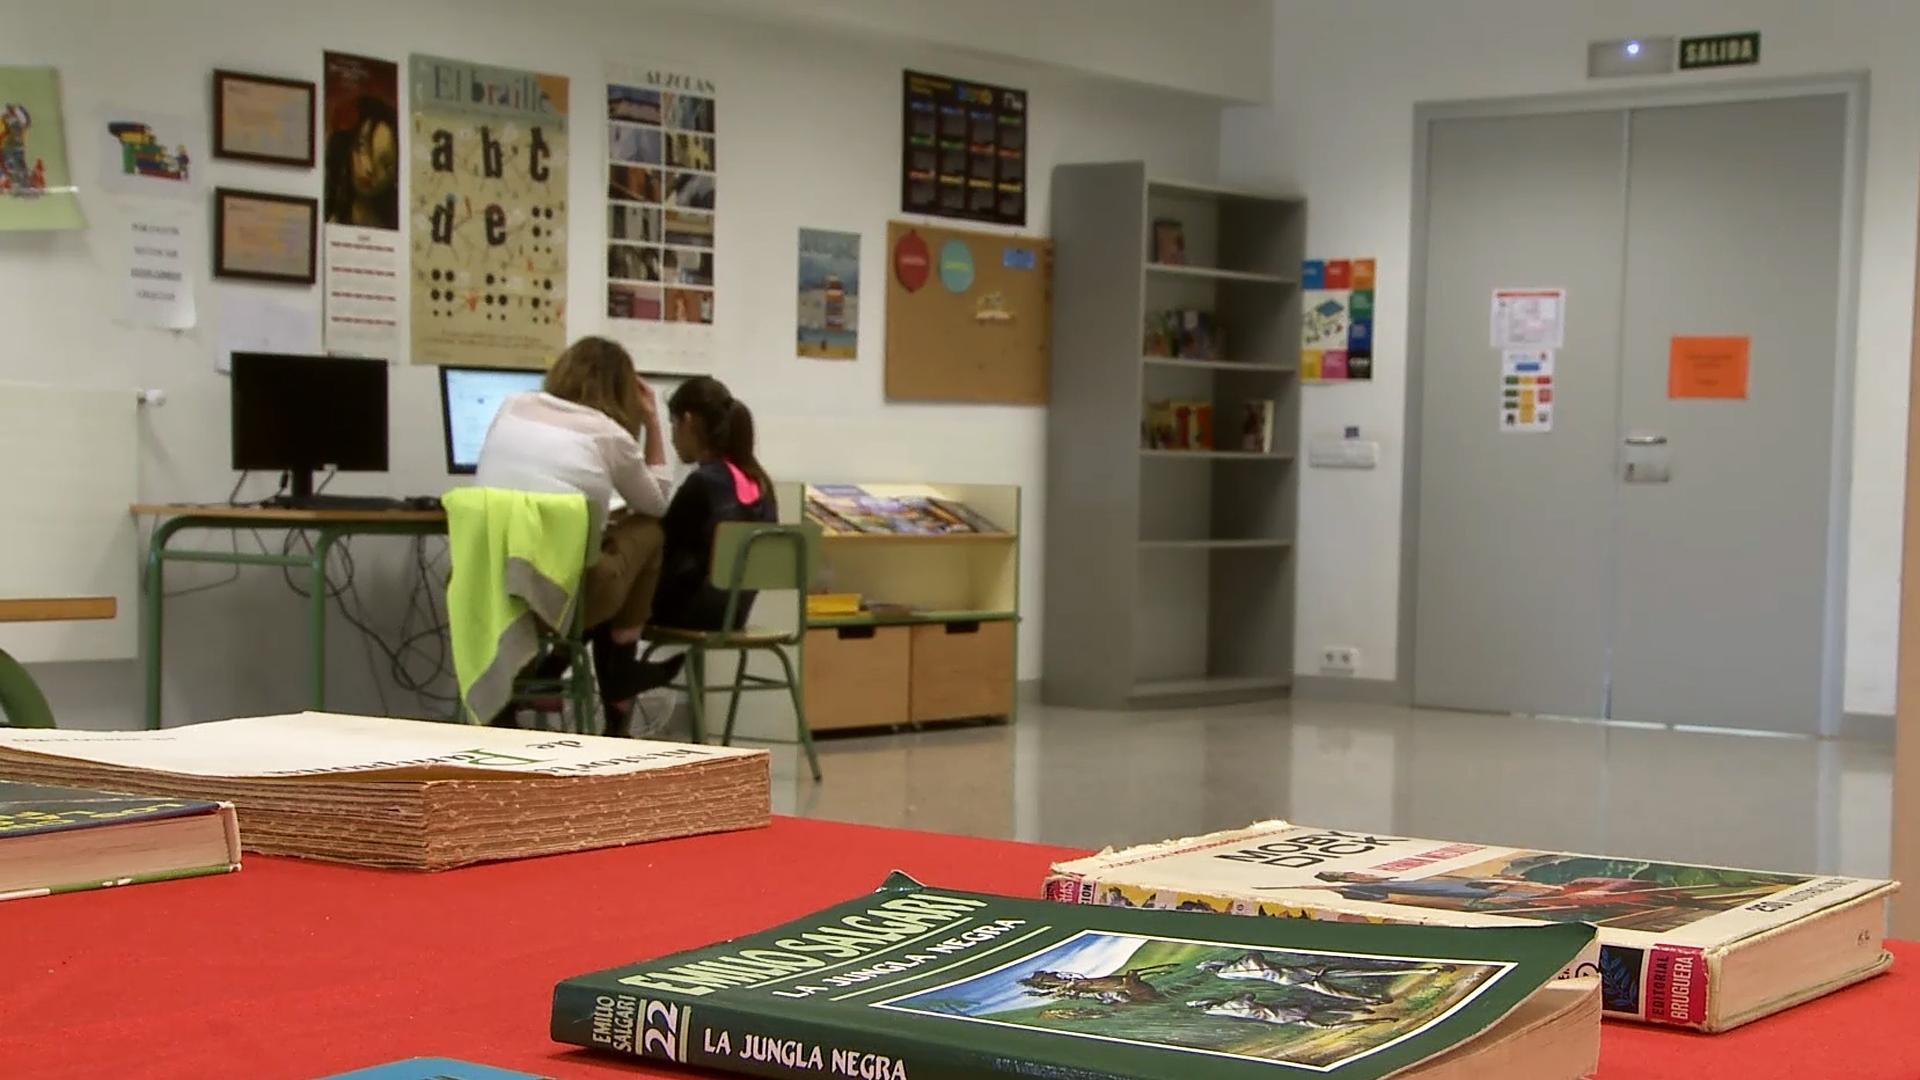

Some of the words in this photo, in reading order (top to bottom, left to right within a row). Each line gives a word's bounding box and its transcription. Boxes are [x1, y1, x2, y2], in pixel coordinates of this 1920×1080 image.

[1686, 39, 1753, 62] SALIDA
[434, 64, 462, 103] El
[470, 68, 551, 114] braille
[431, 130, 454, 172] a
[482, 126, 502, 178] b
[431, 197, 455, 245] d
[485, 203, 506, 246] e
[1214, 831, 1360, 863] MOBY
[1260, 836, 1411, 868] DICK
[617, 948, 802, 996] EMILIO
[776, 893, 990, 968] SALGARI
[772, 984, 829, 1001] LA
[826, 950, 938, 988] JUNGLA
[928, 918, 1027, 954] NEGRA
[1652, 955, 1669, 1016] EDITORIAL
[1671, 957, 1694, 1020] BRUGUERA
[592, 995, 616, 1044] EMILIO
[612, 994, 637, 1053] SALGARI
[644, 1000, 678, 1062] 22
[704, 1027, 732, 1056] LA
[739, 1033, 824, 1072] JUNGLA
[831, 1050, 908, 1080] NEGRA
